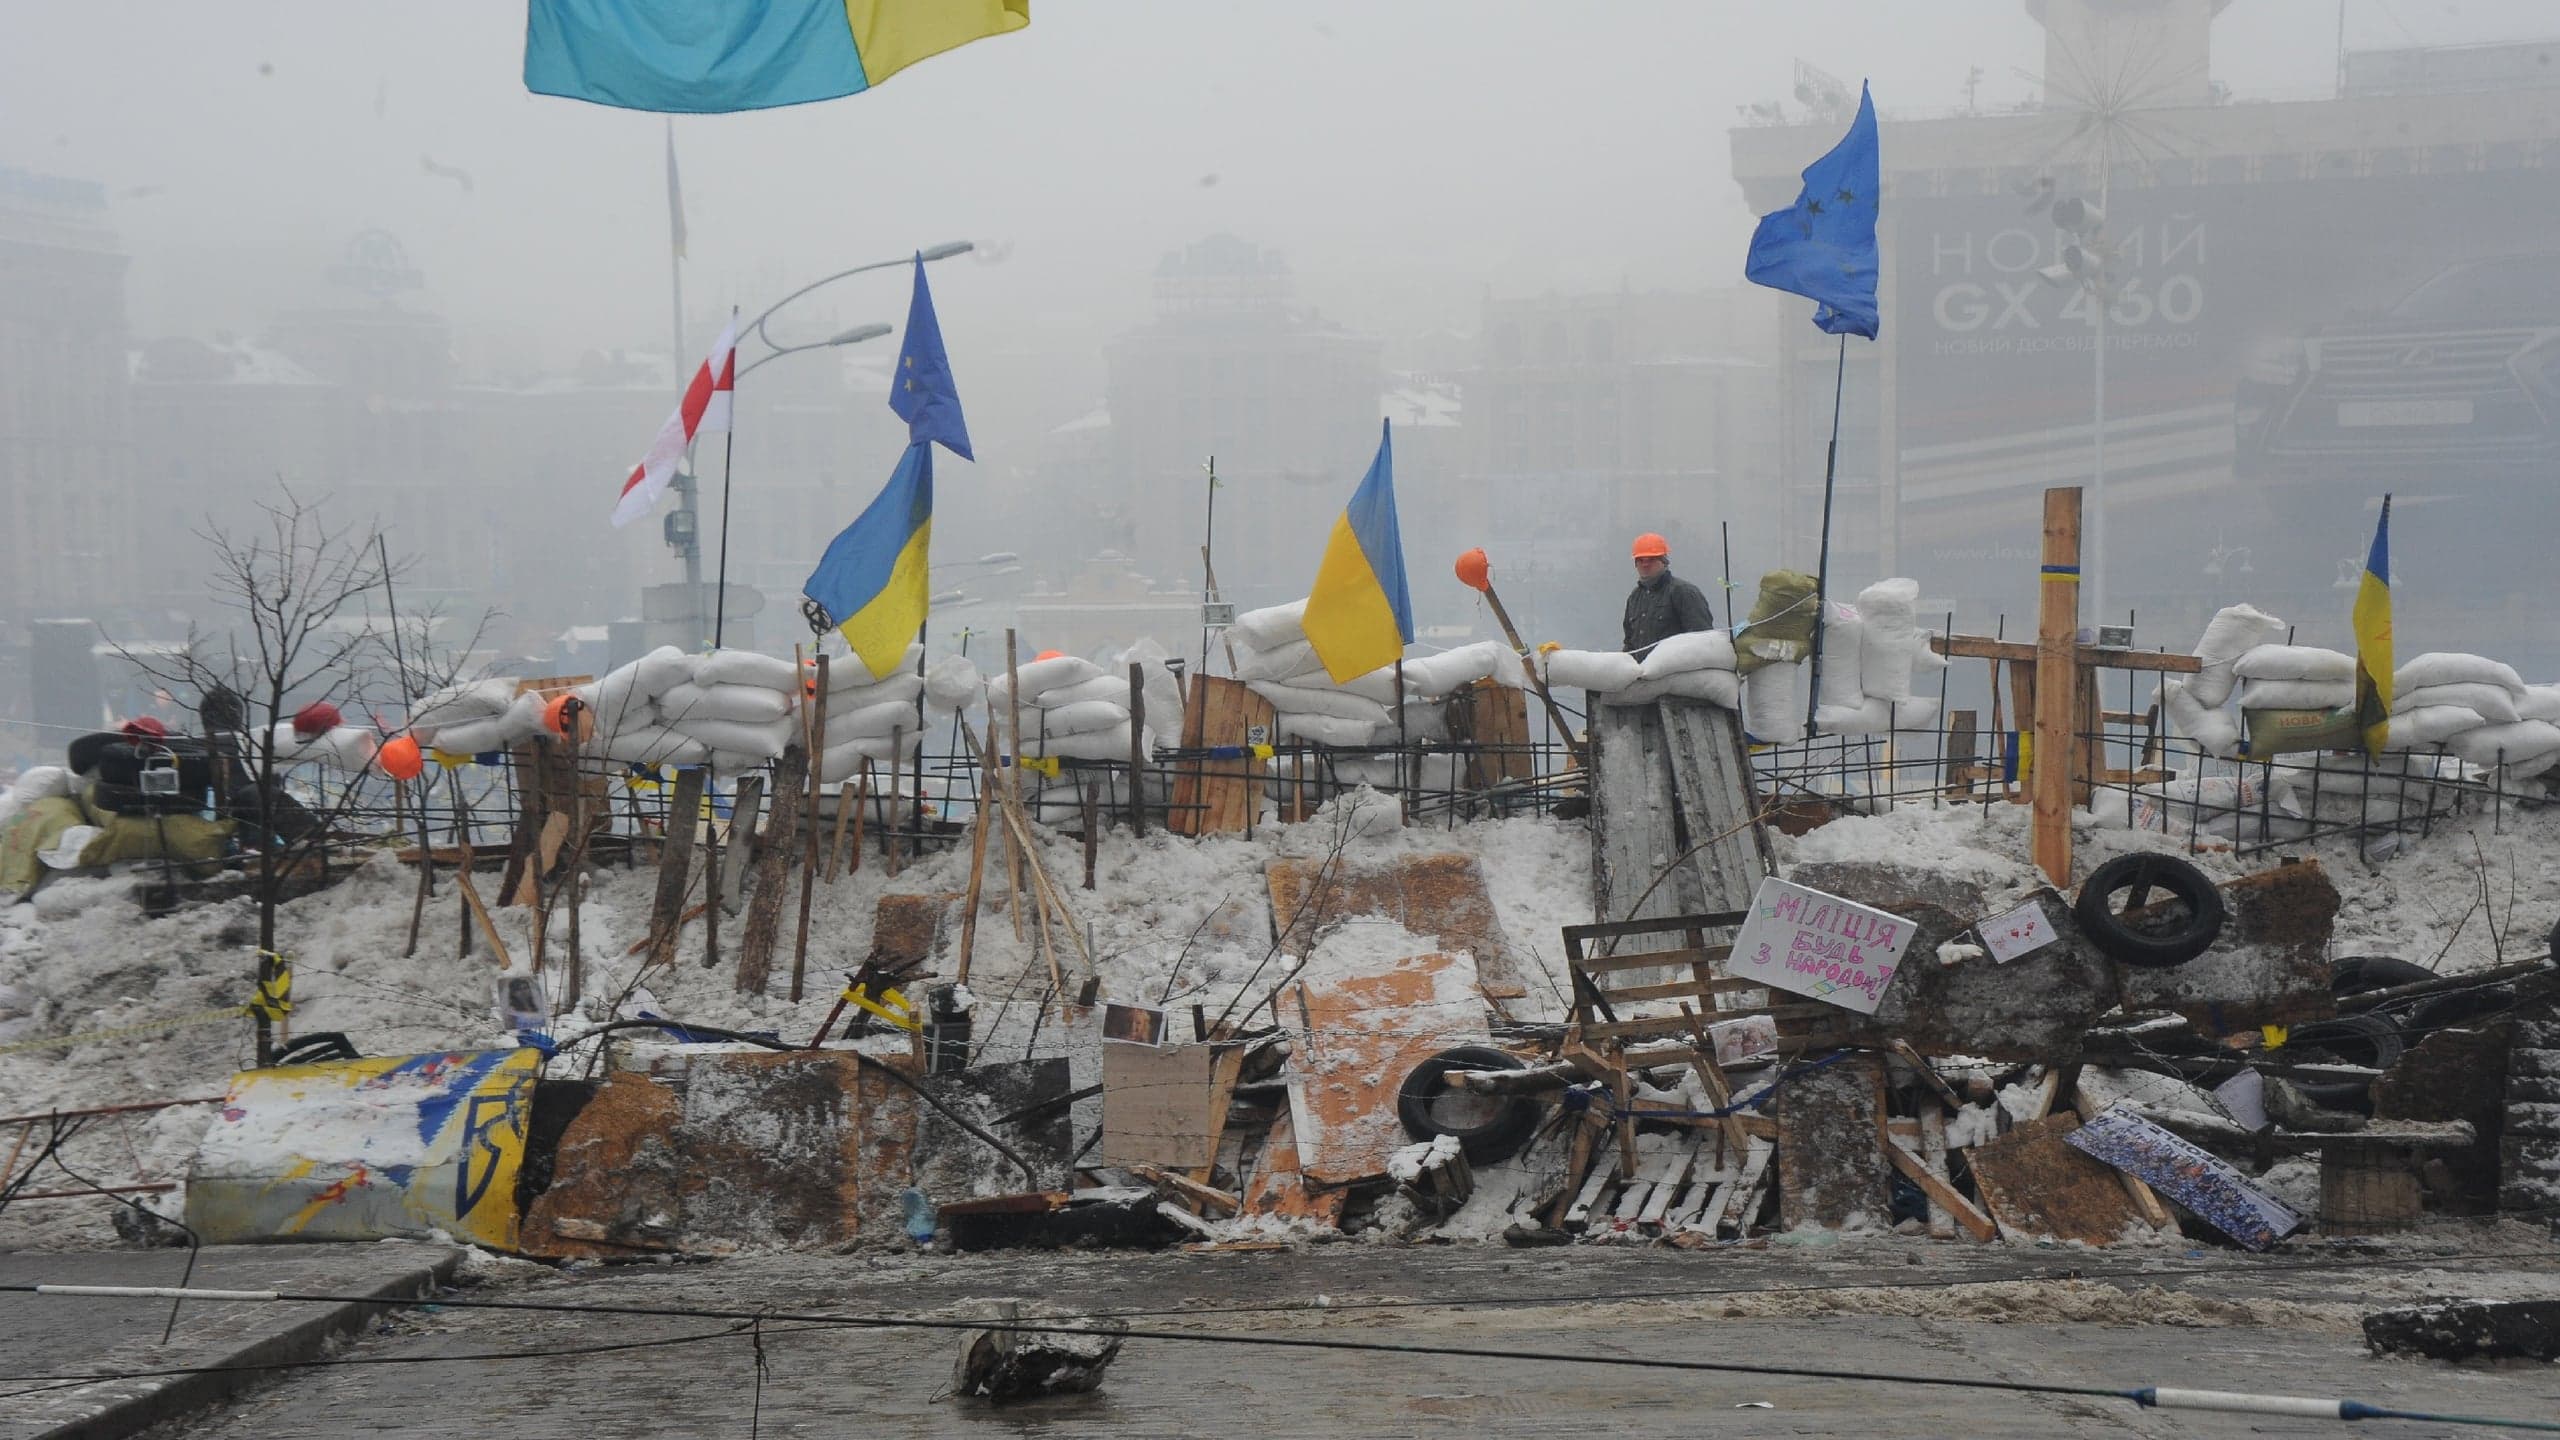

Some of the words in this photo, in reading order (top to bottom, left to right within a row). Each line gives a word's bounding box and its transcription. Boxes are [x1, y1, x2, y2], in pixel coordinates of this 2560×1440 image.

[1932, 281, 2041, 332] GX
[2058, 274, 2204, 328] 460
[1933, 335, 2011, 356] НОВИЙ
[2016, 334, 2098, 355] ДОСВІД
[1791, 930, 1865, 965] БУДЬ
[2113, 1107, 2144, 1125] GO
[2147, 1124, 2228, 1171] PEOPLE
